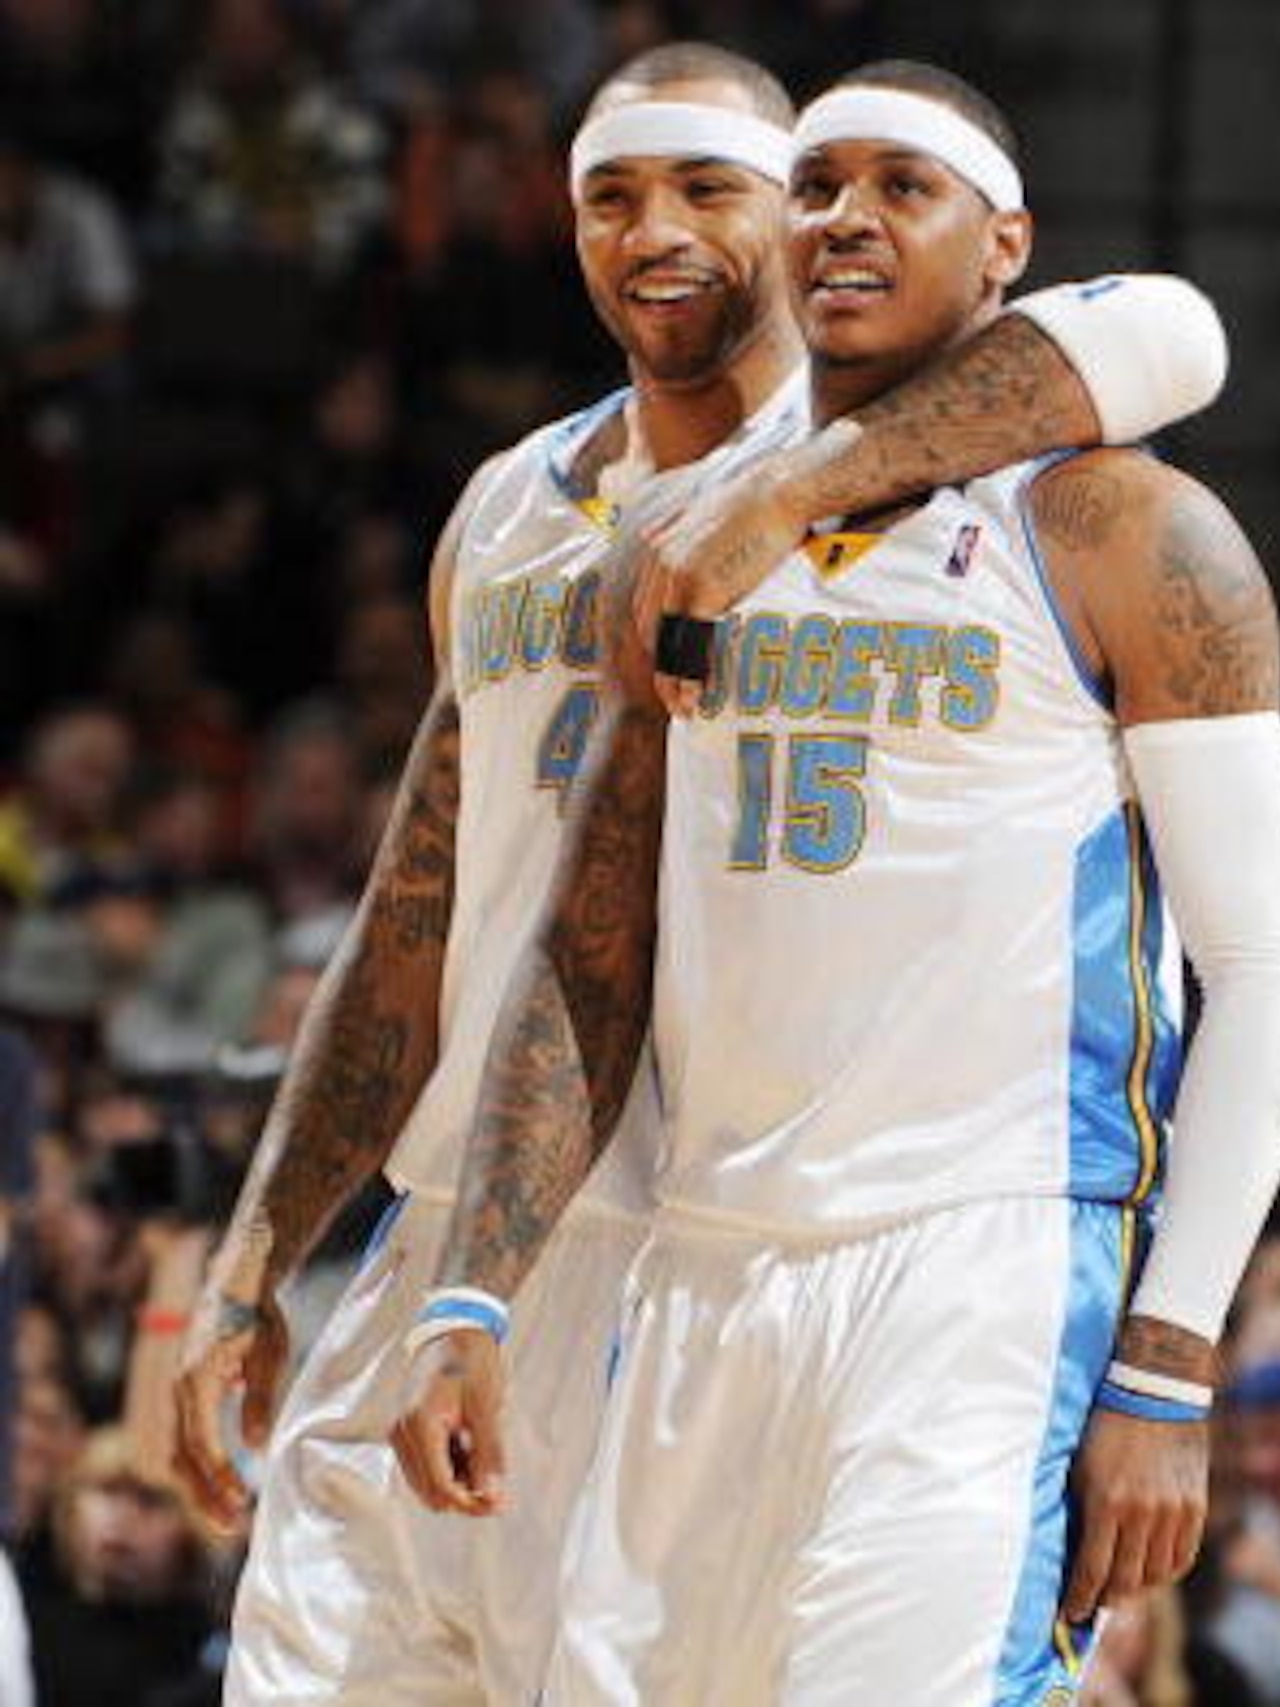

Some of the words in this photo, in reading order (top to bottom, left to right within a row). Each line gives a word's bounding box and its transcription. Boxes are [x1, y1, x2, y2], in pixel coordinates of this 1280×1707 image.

[466, 572, 606, 690] NUGG
[698, 612, 1001, 733] UGGETS
[535, 682, 602, 815] 4
[725, 732, 868, 875] 15
